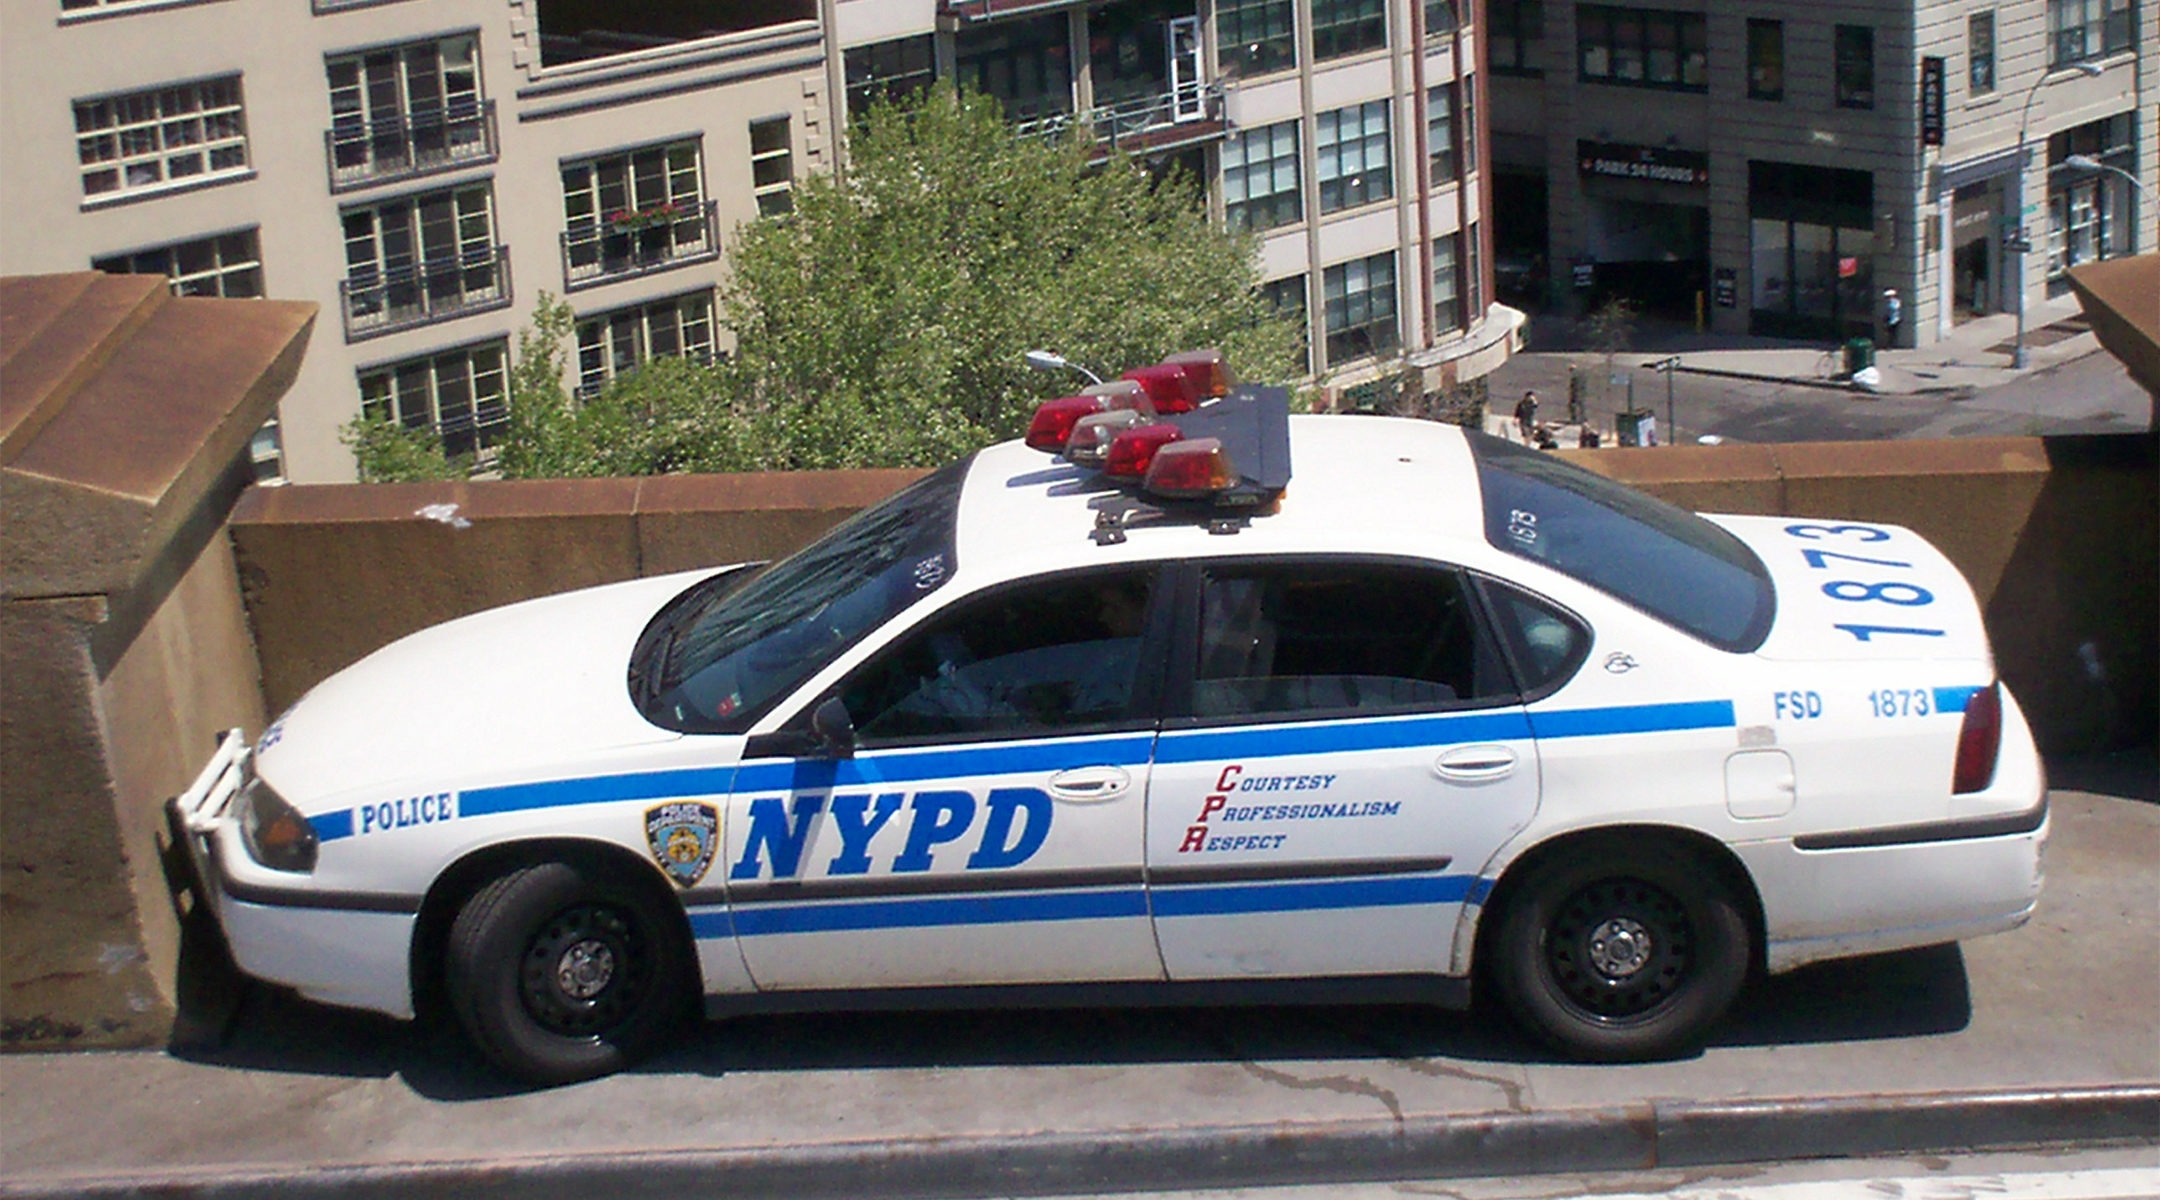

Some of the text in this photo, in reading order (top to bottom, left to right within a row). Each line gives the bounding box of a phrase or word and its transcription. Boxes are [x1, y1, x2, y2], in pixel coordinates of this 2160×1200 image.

[1926, 72, 1938, 115] PARK
[1594, 158, 1692, 182] PARK 24 HOURS
[1508, 509, 1537, 544] 1873
[1784, 525, 1946, 641] 1873
[1774, 688, 1929, 720] FSD 1873
[1216, 765, 1337, 792] COURTESY
[361, 792, 452, 834] POLICE
[1196, 795, 1402, 823] PROFESSIONALISM
[730, 787, 1053, 880] NYPD
[1178, 826, 1287, 853] RESPECT
